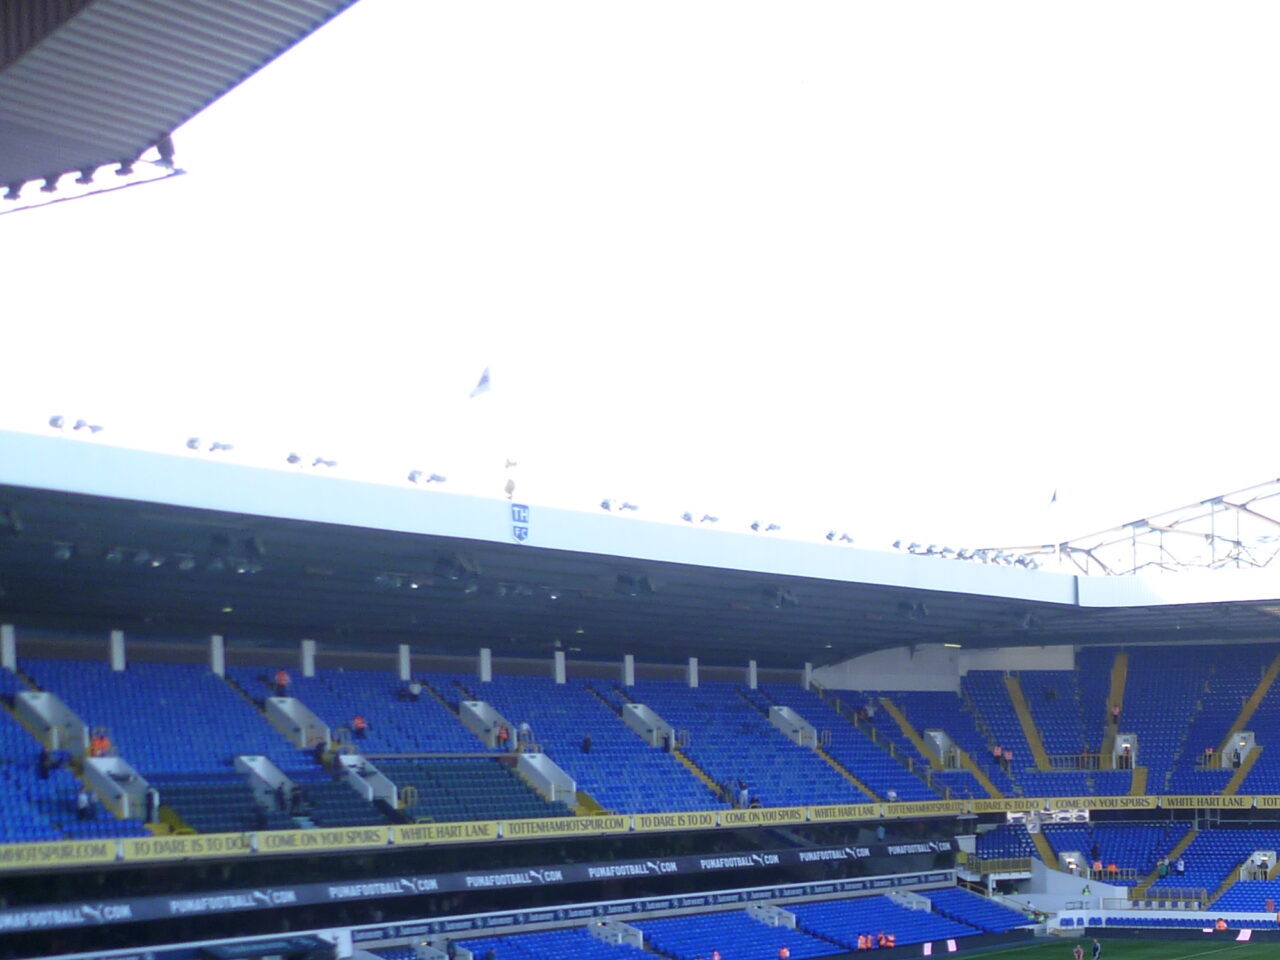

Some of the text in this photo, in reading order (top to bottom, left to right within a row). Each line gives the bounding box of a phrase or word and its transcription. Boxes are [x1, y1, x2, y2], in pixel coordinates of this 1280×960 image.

[512, 507, 528, 521] TH
[1004, 801, 1012, 810] IS
[1014, 801, 1024, 809] TO
[1026, 800, 1038, 809] DO
[1056, 798, 1150, 809] COME ON YOU SPURS
[1168, 797, 1245, 807] WHITE HART LANE
[726, 808, 800, 823] COME ON YOU SPURS
[815, 804, 874, 818] WHITE HART LANE
[508, 818, 624, 834] TOTTENHAMHOTSPUR.COM
[640, 812, 712, 828] TO DARE IS TO DO
[436, 826, 461, 838] HART
[464, 824, 489, 836] LANE
